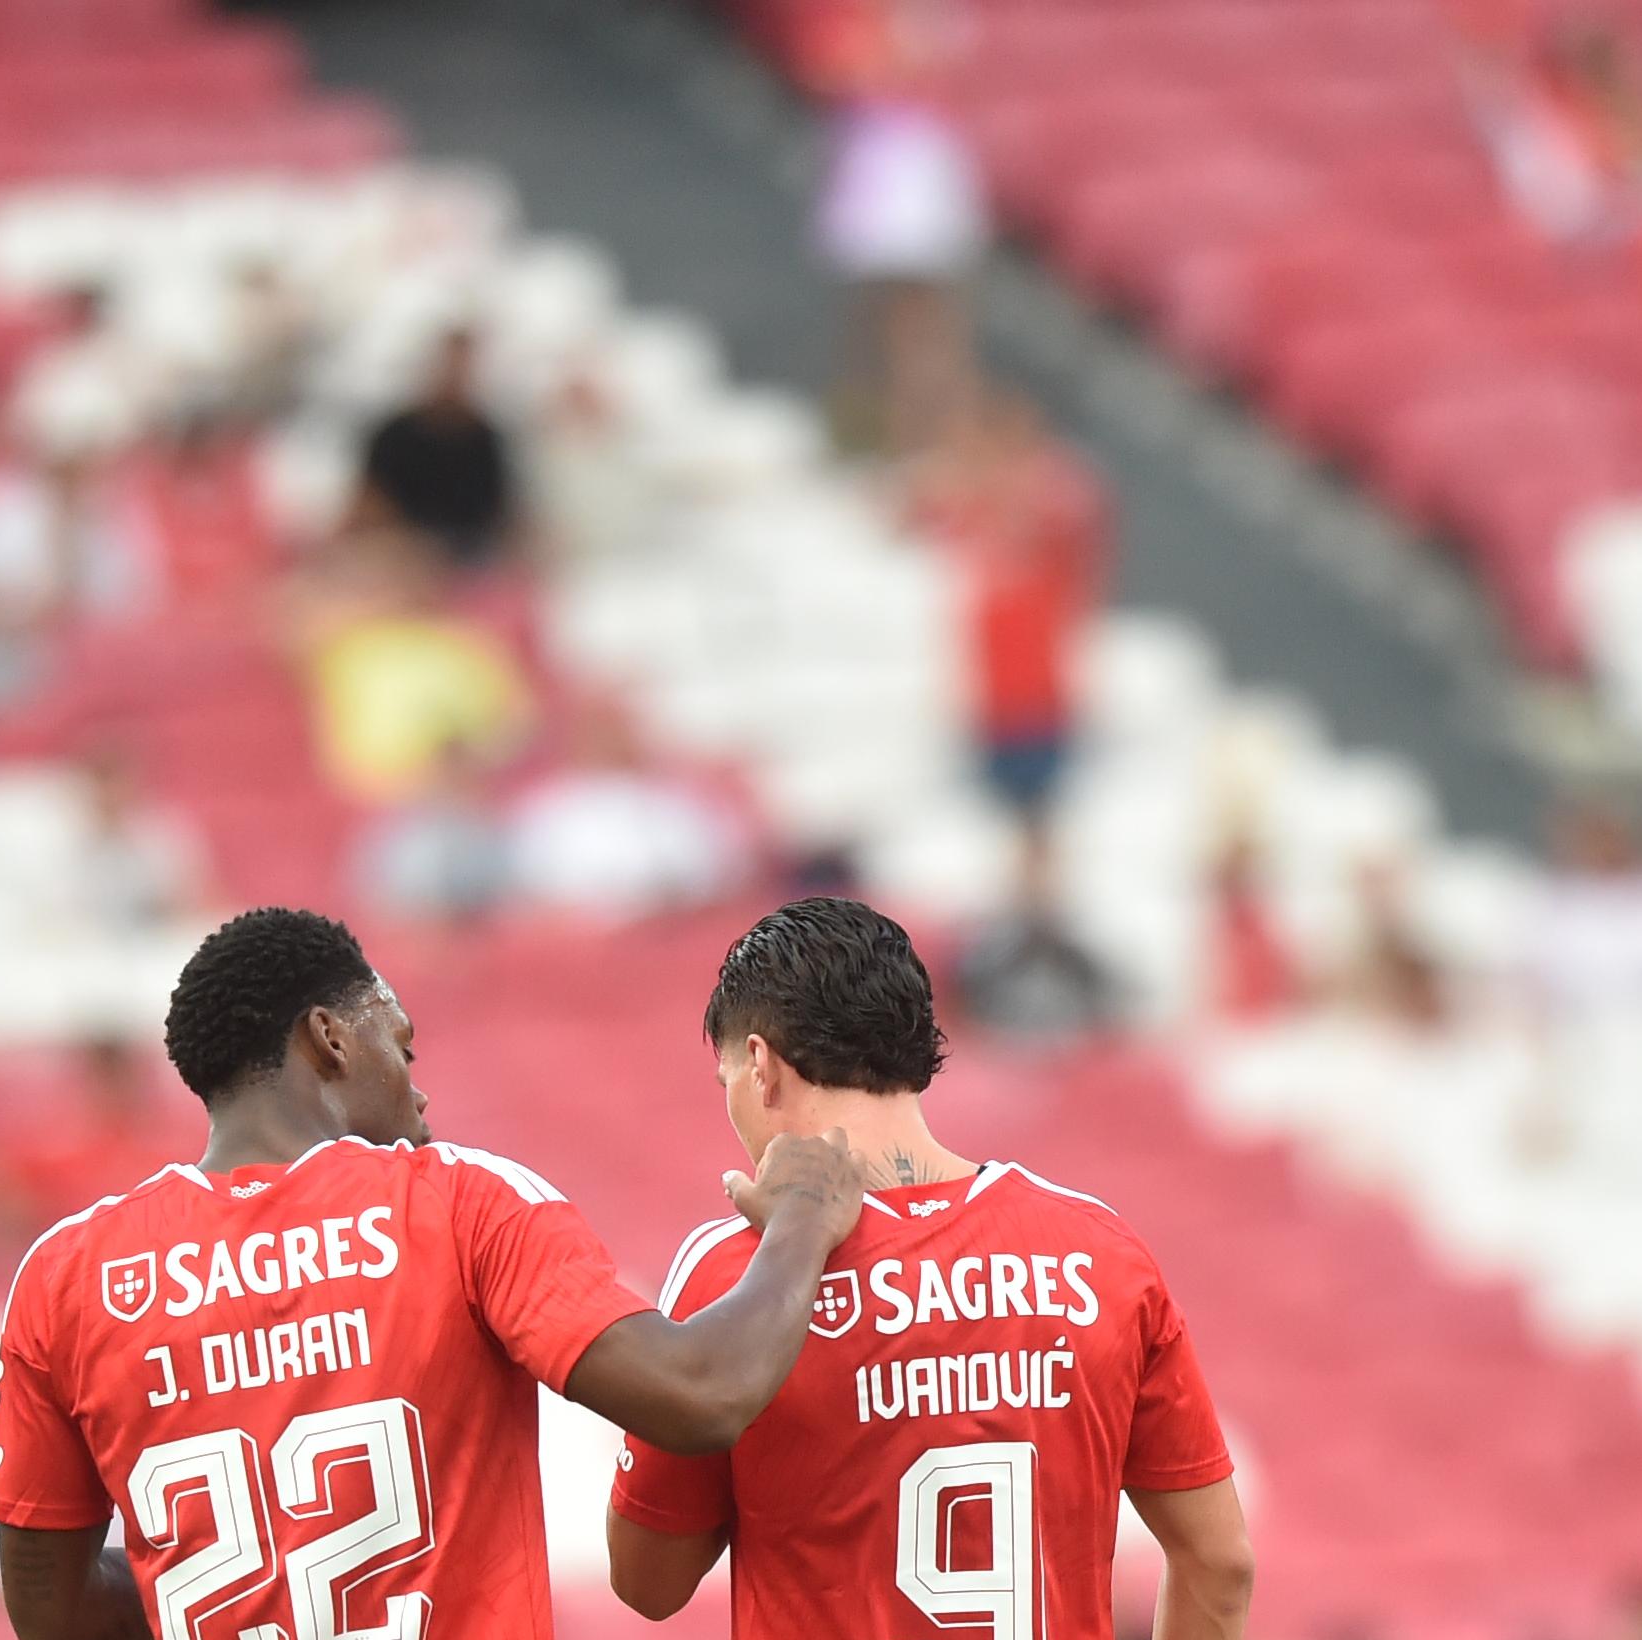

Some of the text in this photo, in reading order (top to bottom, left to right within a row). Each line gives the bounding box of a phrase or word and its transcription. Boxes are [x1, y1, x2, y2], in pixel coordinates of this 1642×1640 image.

[165, 1206, 399, 1317] SAGRES
[868, 1251, 1100, 1334] SAGRES
[143, 1306, 372, 1407] J. DURAN
[856, 1336, 1074, 1422] IVANOVIĆ
